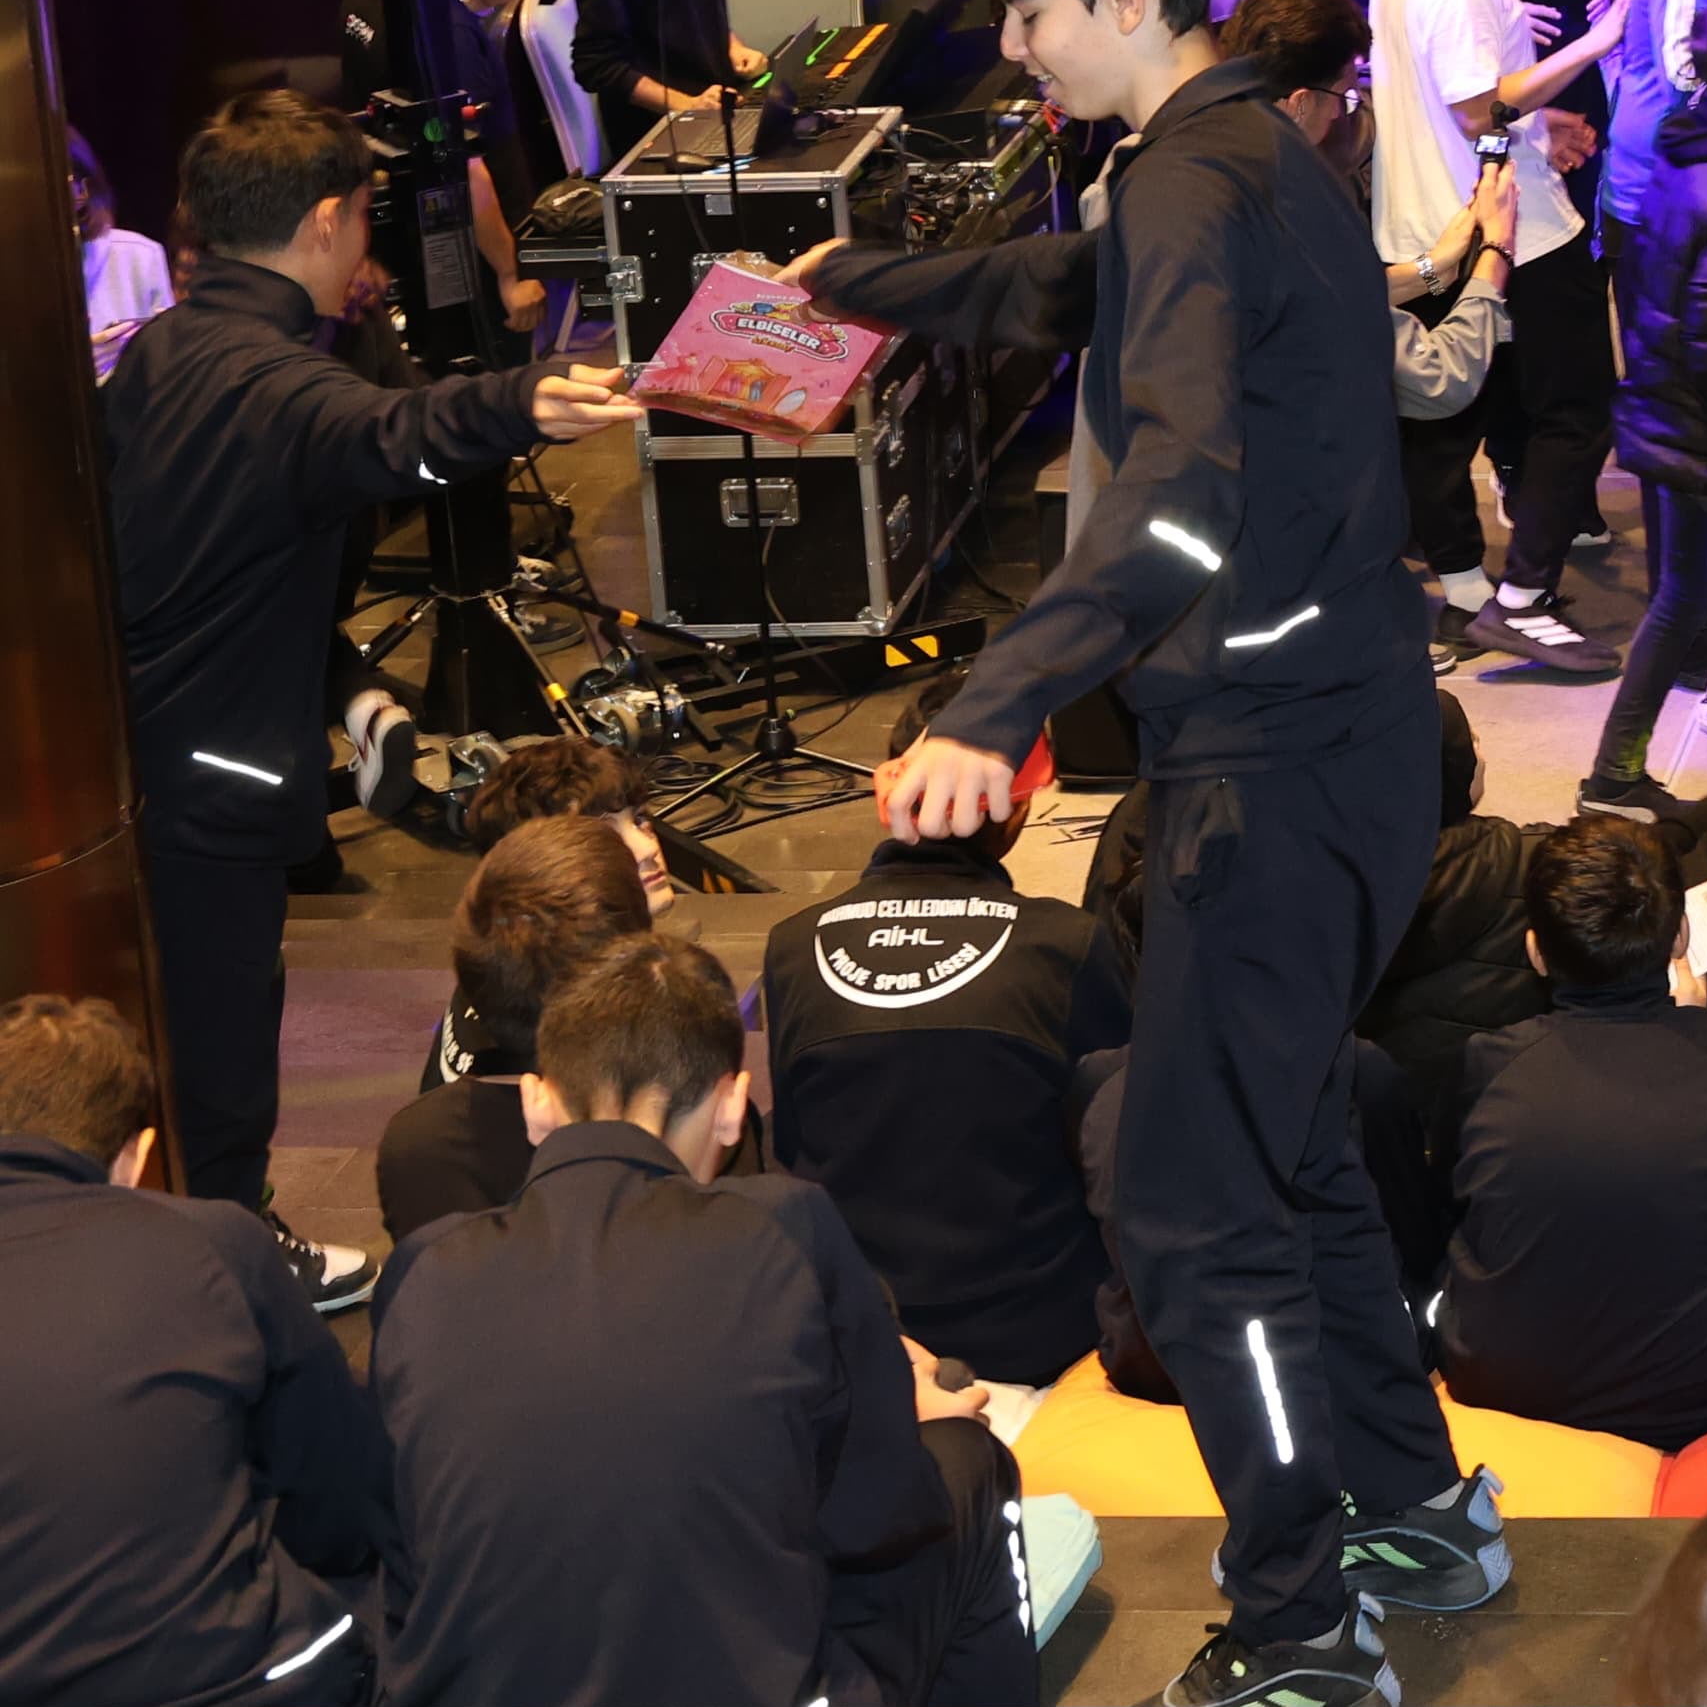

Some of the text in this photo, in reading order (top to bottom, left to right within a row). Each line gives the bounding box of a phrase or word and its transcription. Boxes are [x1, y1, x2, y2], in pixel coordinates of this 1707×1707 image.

[737, 317, 822, 350] ELBİSELER
[967, 897, 1019, 920] ÖKTEN
[828, 947, 872, 986] PROJE
[873, 972, 922, 991] SPOR
